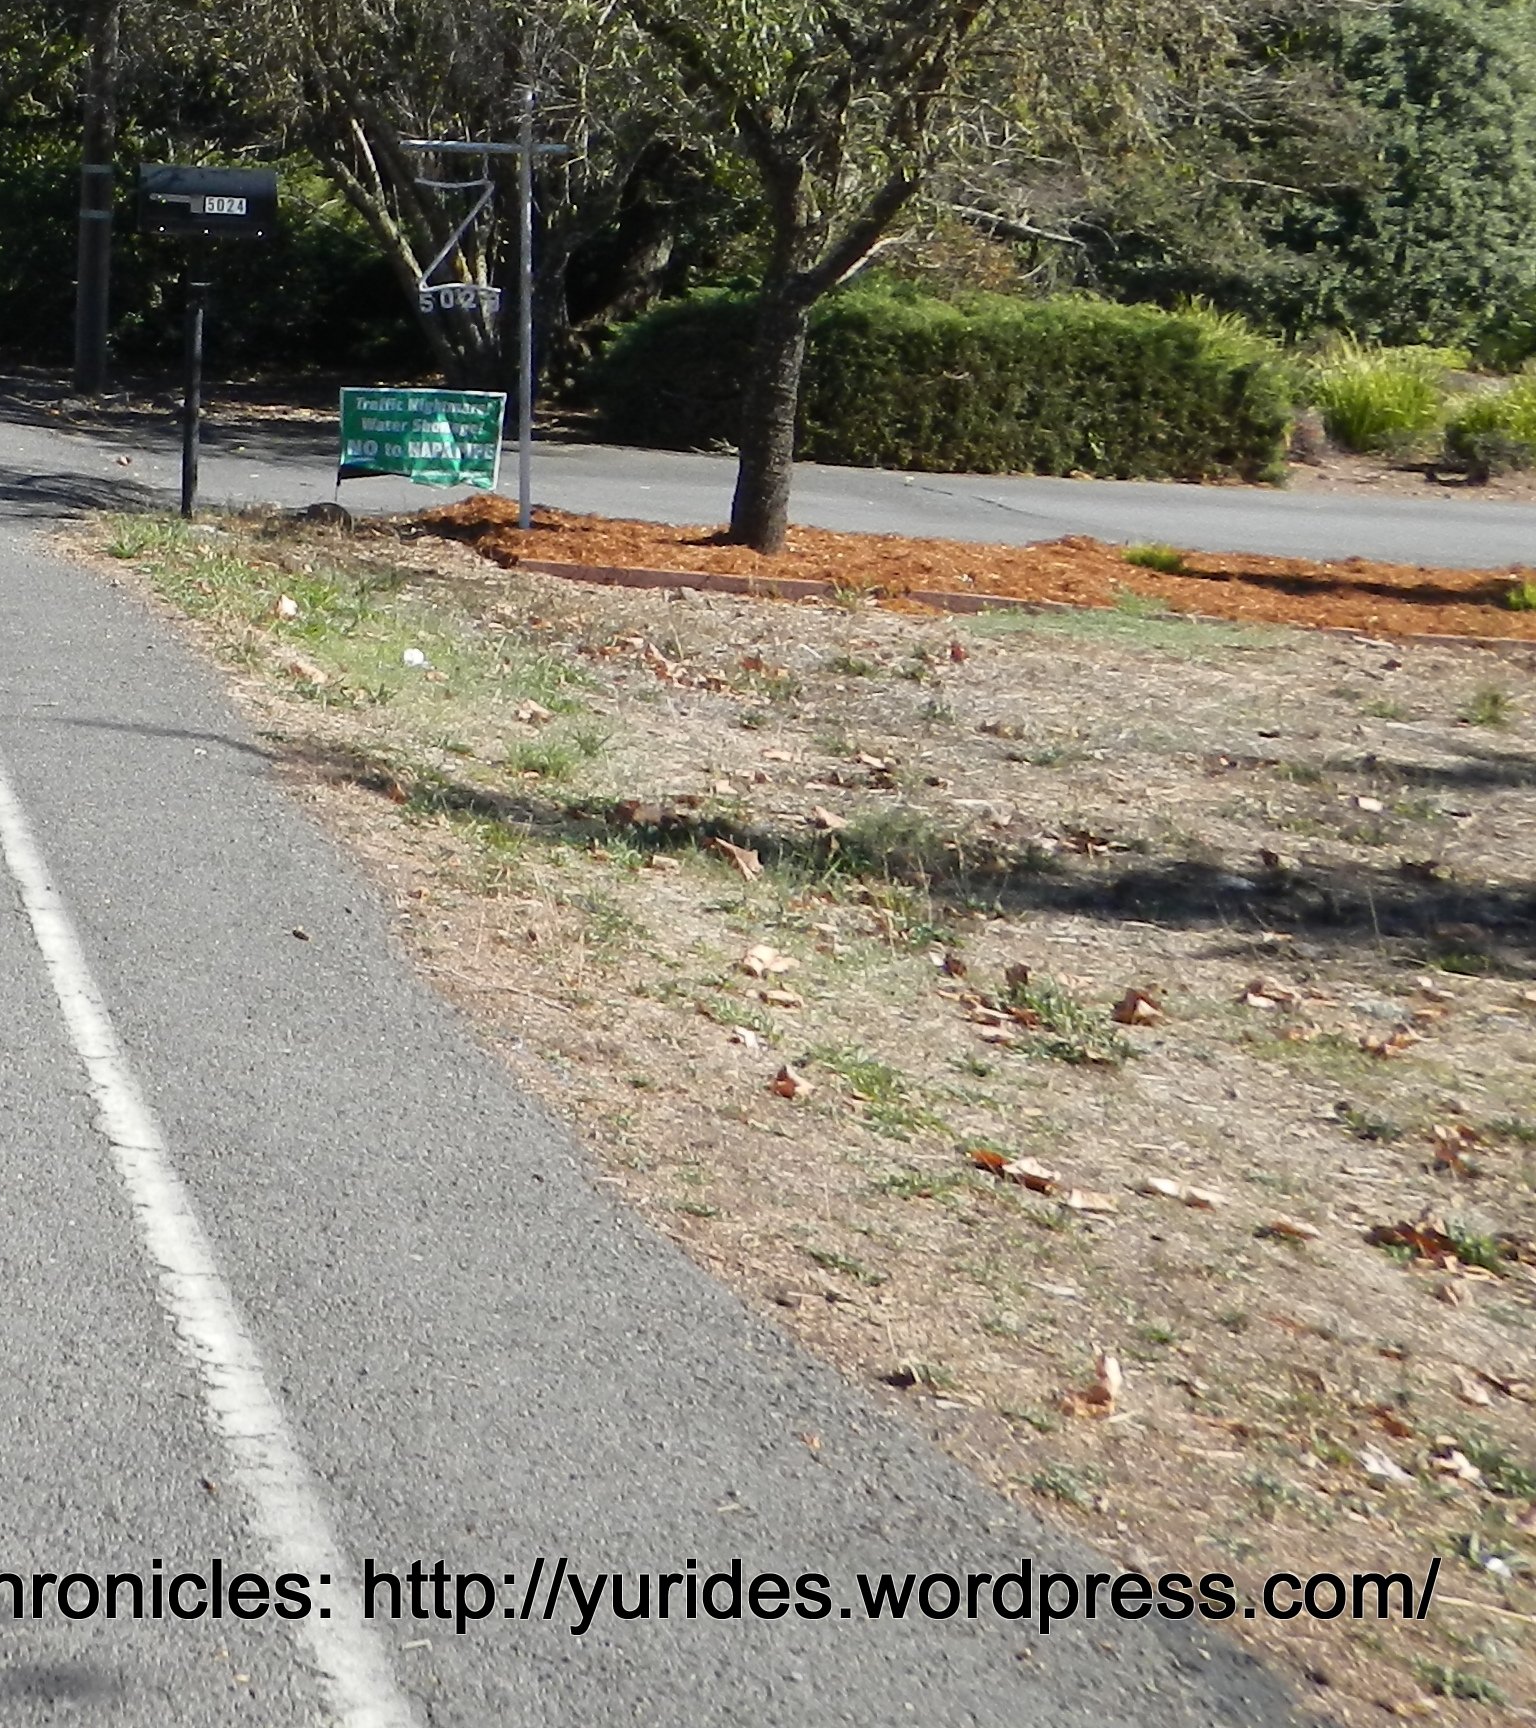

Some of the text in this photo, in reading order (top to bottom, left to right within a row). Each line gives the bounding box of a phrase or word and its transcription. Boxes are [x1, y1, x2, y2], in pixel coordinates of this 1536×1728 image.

[206, 196, 245, 215] 5024
[356, 397, 403, 411] Traffic
[361, 417, 408, 432] Water
[347, 439, 379, 456] NO
[384, 442, 402, 457] to
[408, 440, 453, 459] NAPA
